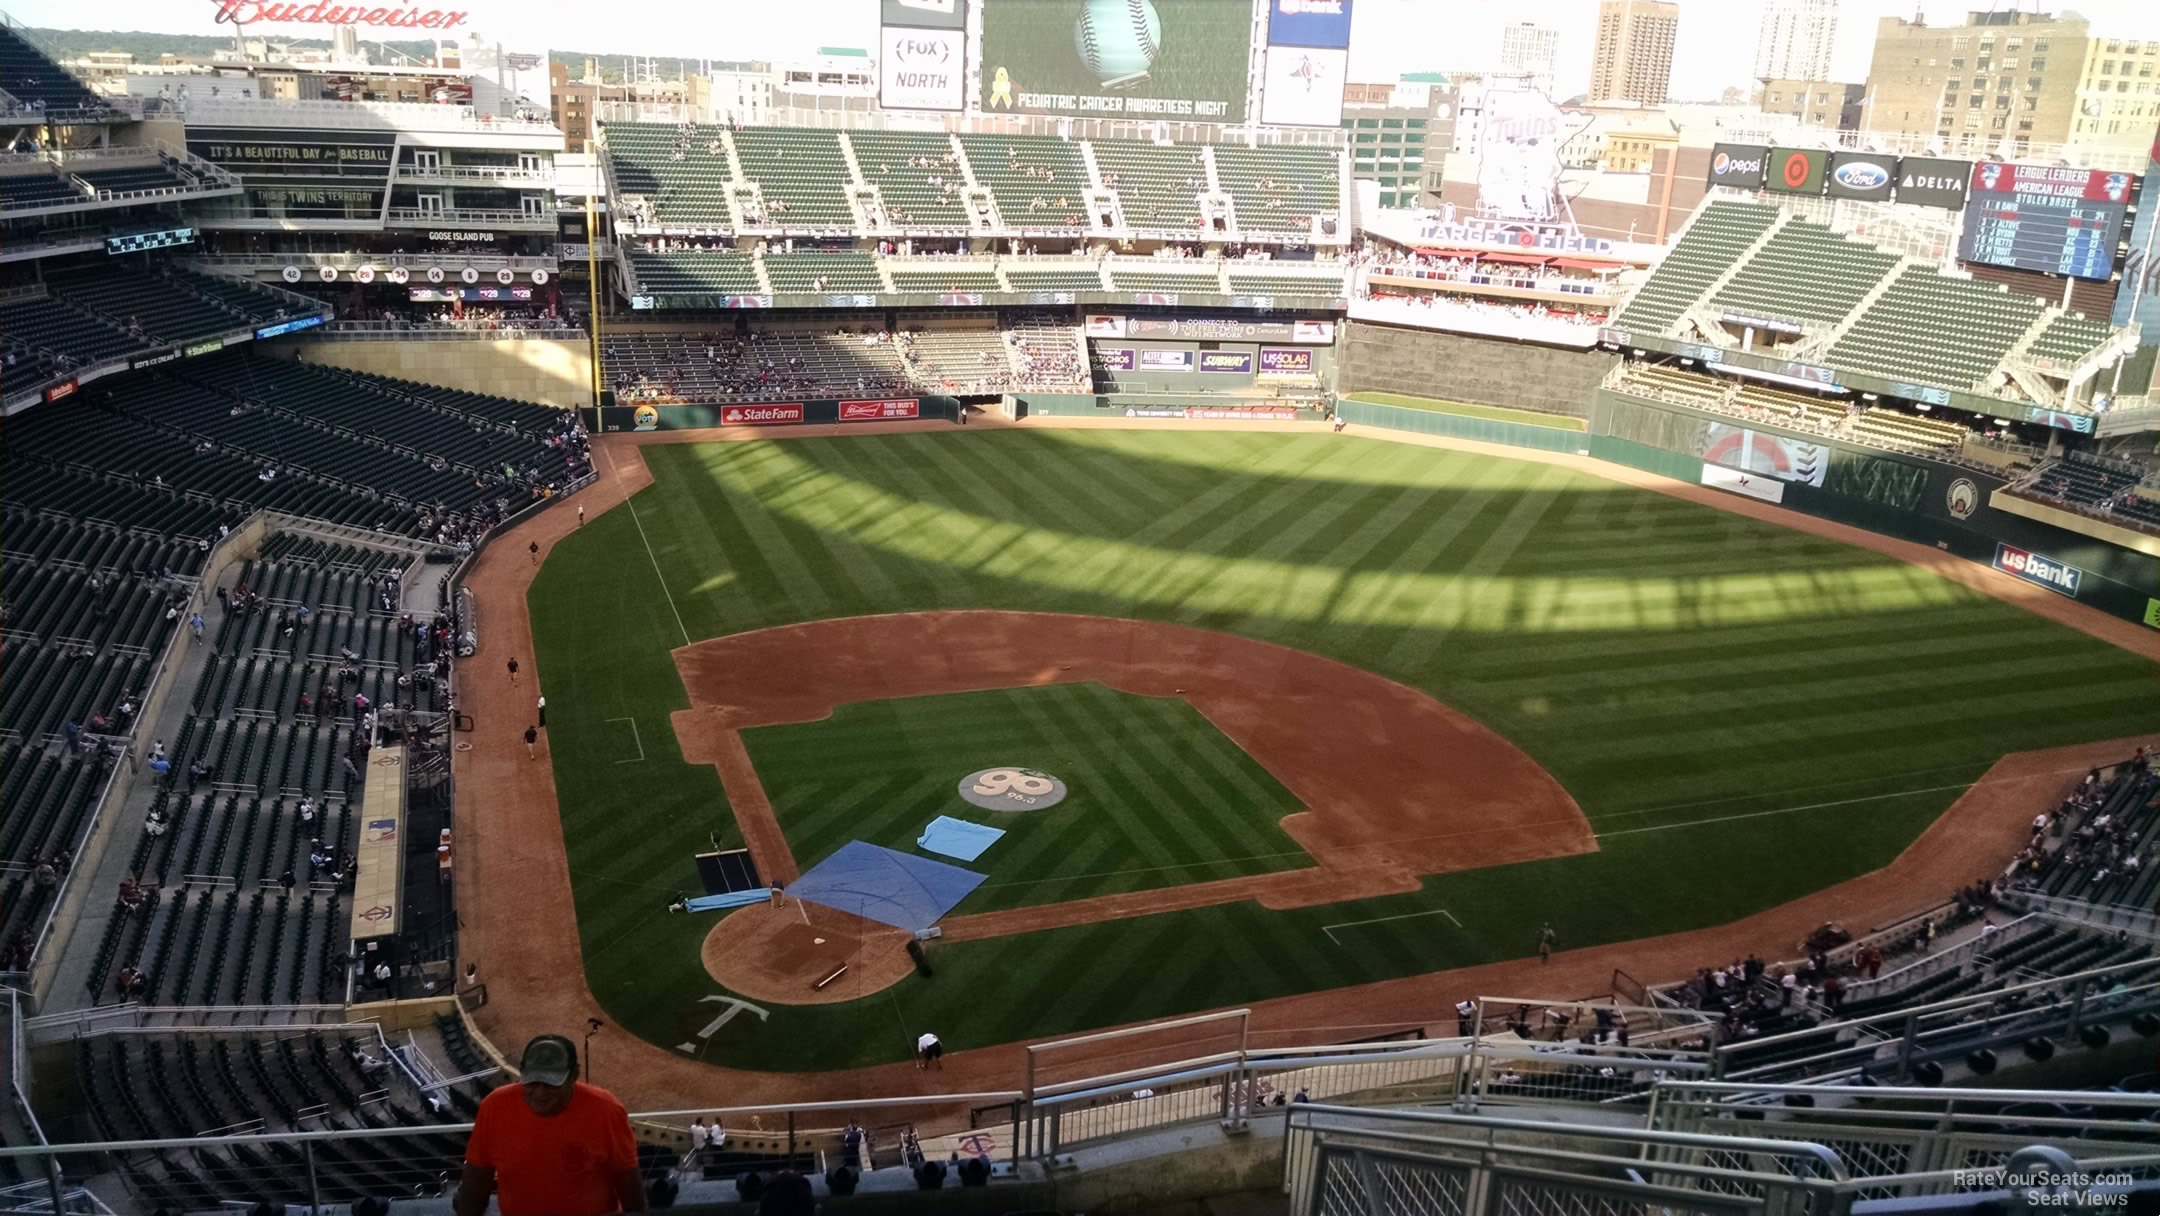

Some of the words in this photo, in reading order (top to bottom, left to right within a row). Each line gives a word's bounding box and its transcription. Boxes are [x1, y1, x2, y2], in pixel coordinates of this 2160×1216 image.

[214, 0, 468, 29] Budweiser
[907, 40, 937, 55] FOX
[896, 72, 948, 88] NORTH
[1018, 93, 1076, 111] PEDIATRIC
[1079, 95, 1123, 112] CANCER
[1126, 97, 1192, 114] AWARENESS
[1195, 100, 1228, 116] NIGHT
[1492, 114, 1558, 143] Twins
[210, 146, 232, 158] IT'S
[236, 147, 242, 158] A
[245, 147, 300, 159] BEAUTIFUL
[303, 148, 320, 159] DAY
[324, 149, 337, 159] for
[340, 149, 388, 161] BASEBALL
[1729, 159, 1760, 173] pepsi
[1843, 166, 1876, 186] Ford
[2014, 166, 2048, 179] LEAGUE
[2048, 168, 2091, 183] LEADERS
[1916, 176, 1962, 191] DELTA
[2012, 182, 2053, 195] AMERICAN
[2053, 184, 2086, 197] LEAGUE
[258, 191, 276, 200] THIS
[277, 191, 287, 201] IS
[289, 191, 325, 204] TWINS
[327, 192, 372, 201] TERRITORY
[2016, 193, 2048, 206] STOLEN
[2049, 197, 2078, 208] BASES
[2071, 209, 2083, 218] CLE
[429, 232, 452, 241] GOOSE
[453, 232, 478, 241] ISLAND
[480, 233, 494, 242] PUB
[1420, 226, 1515, 246] TARGET
[1540, 233, 1613, 255] FIELD
[500, 272, 510, 280] 29
[537, 272, 543, 281] 3
[158, 354, 174, 364] CREAM
[1202, 355, 1250, 367] SUBWAY
[1007, 792, 1036, 804] 96.3
